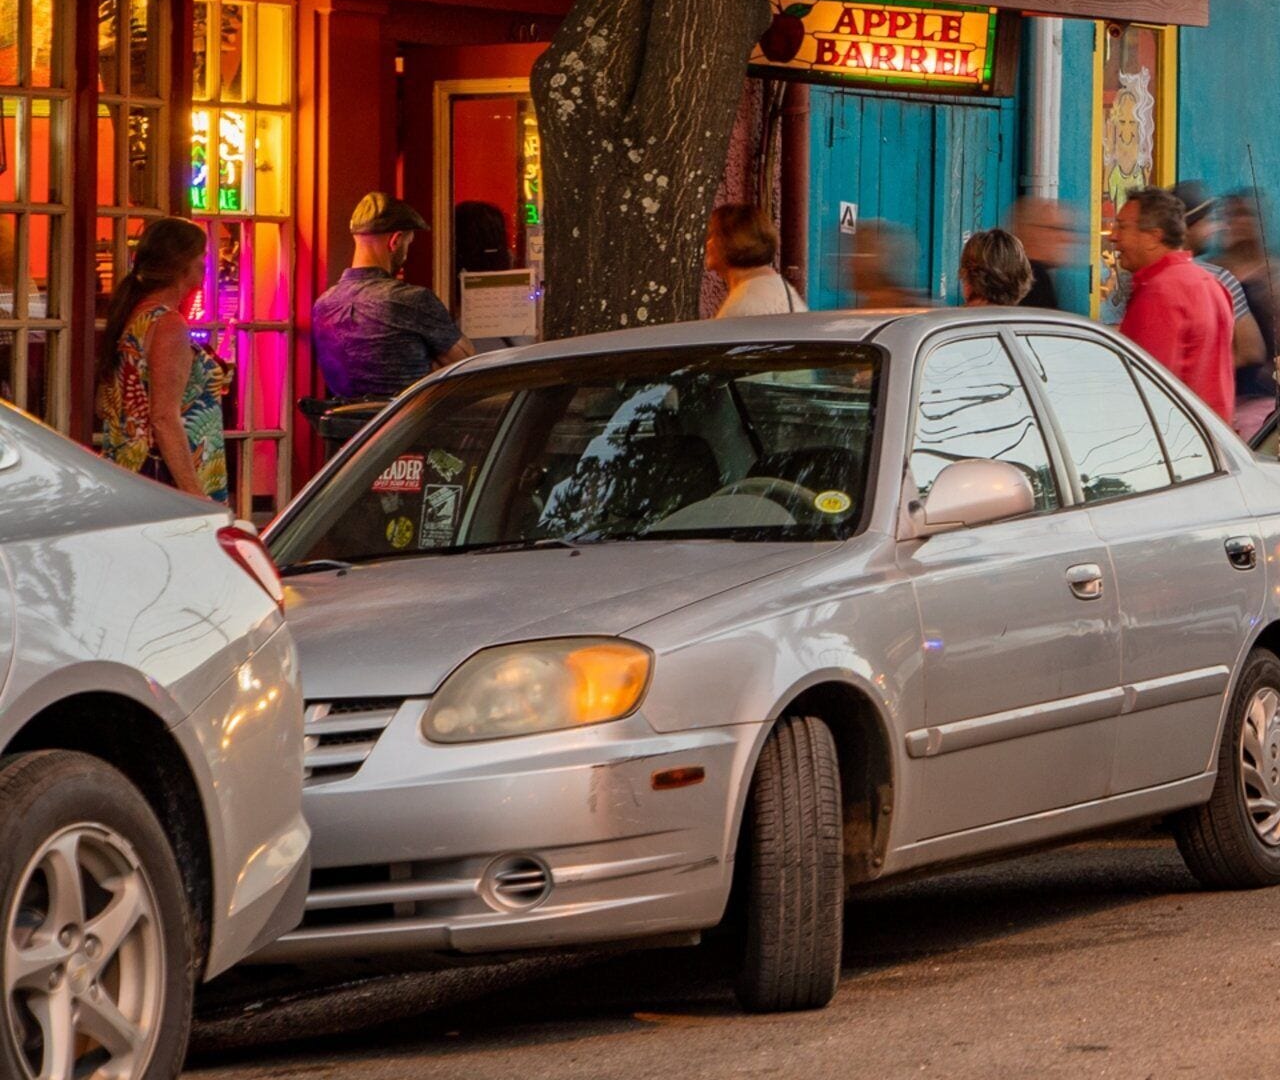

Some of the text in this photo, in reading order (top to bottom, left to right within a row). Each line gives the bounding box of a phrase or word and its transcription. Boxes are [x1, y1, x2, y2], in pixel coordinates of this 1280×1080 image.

[833, 7, 962, 43] APPLE
[816, 38, 979, 77] BARREL
[379, 460, 422, 479] EADER
